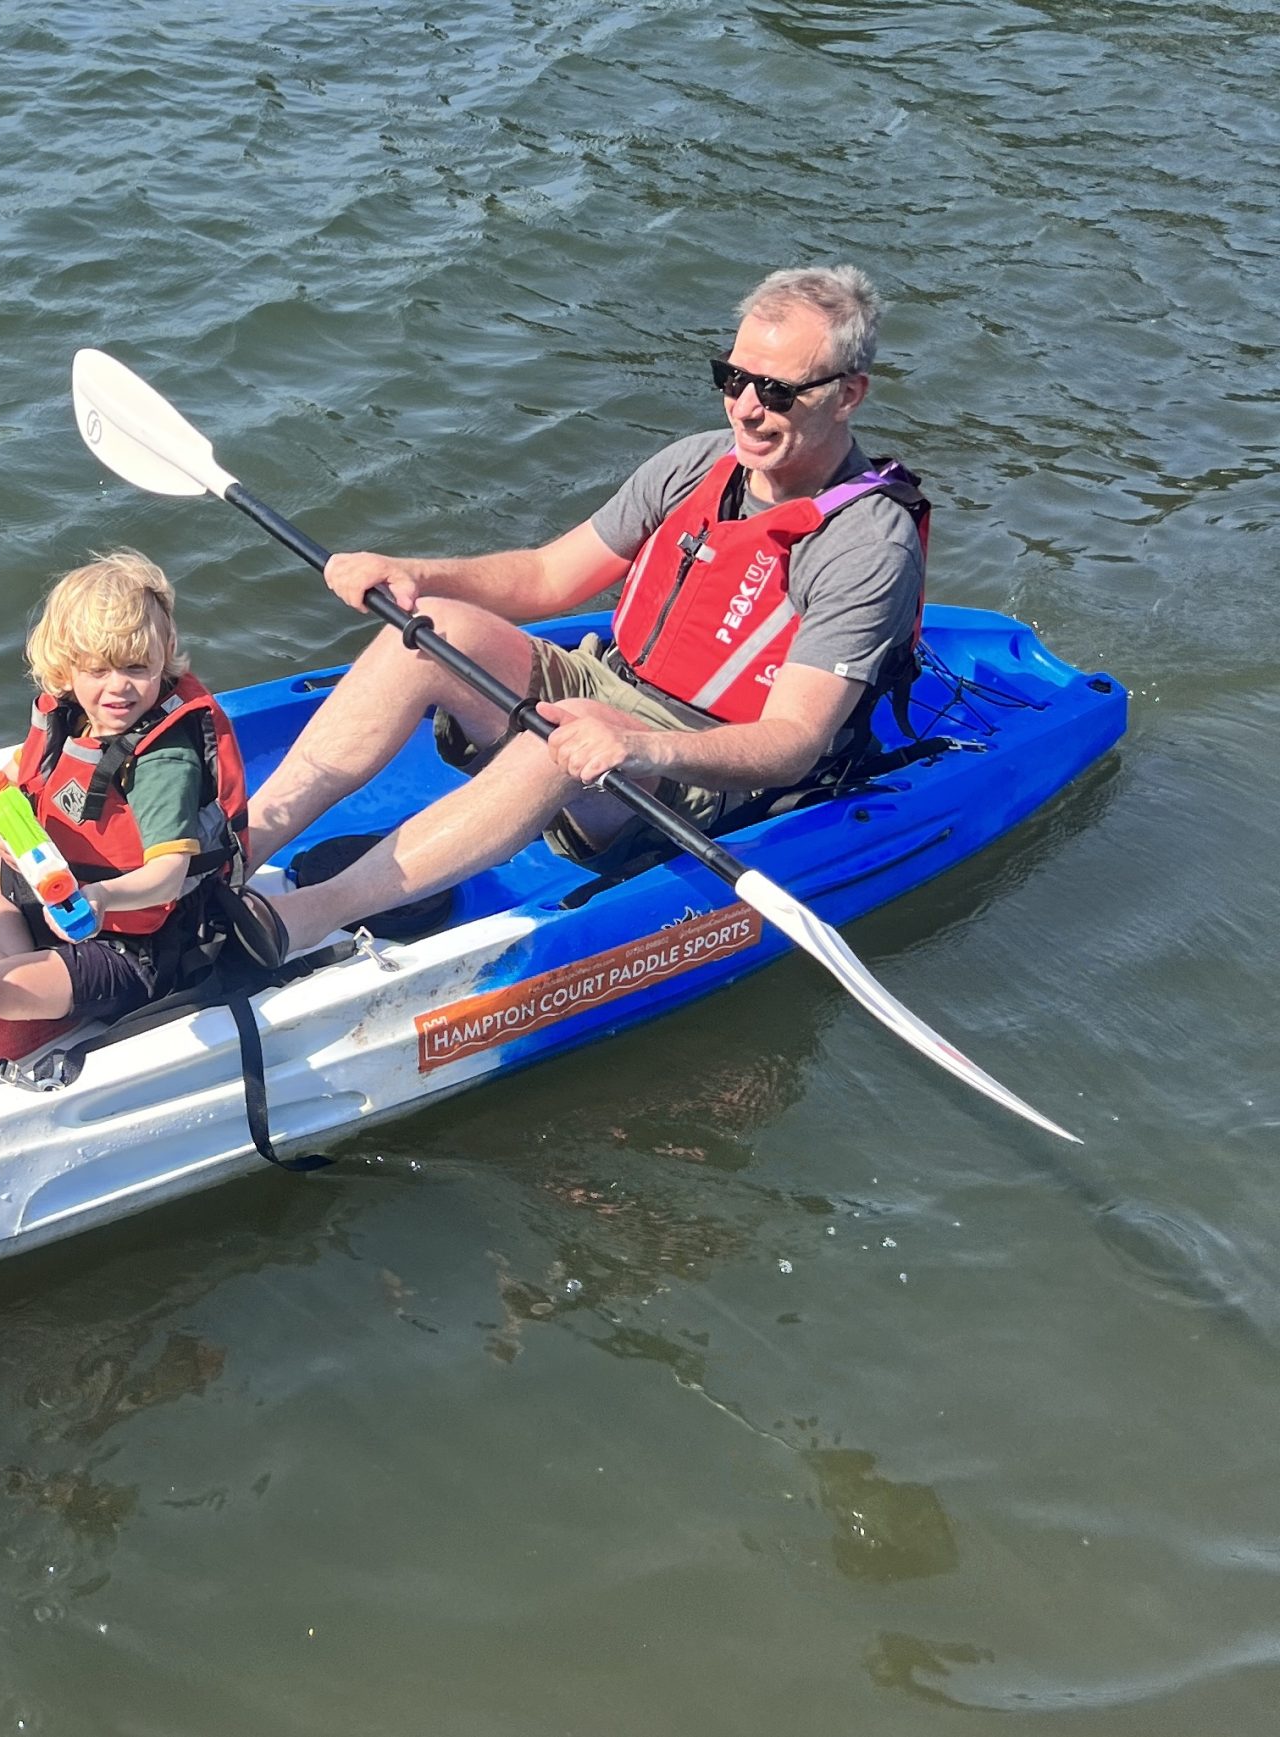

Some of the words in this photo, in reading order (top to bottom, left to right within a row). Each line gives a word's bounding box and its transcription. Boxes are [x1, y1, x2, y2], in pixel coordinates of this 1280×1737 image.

[434, 999, 536, 1051] HAMPTON
[540, 970, 606, 1013] COURT
[609, 944, 681, 986] PADDLE
[683, 918, 751, 959] SPORTS
